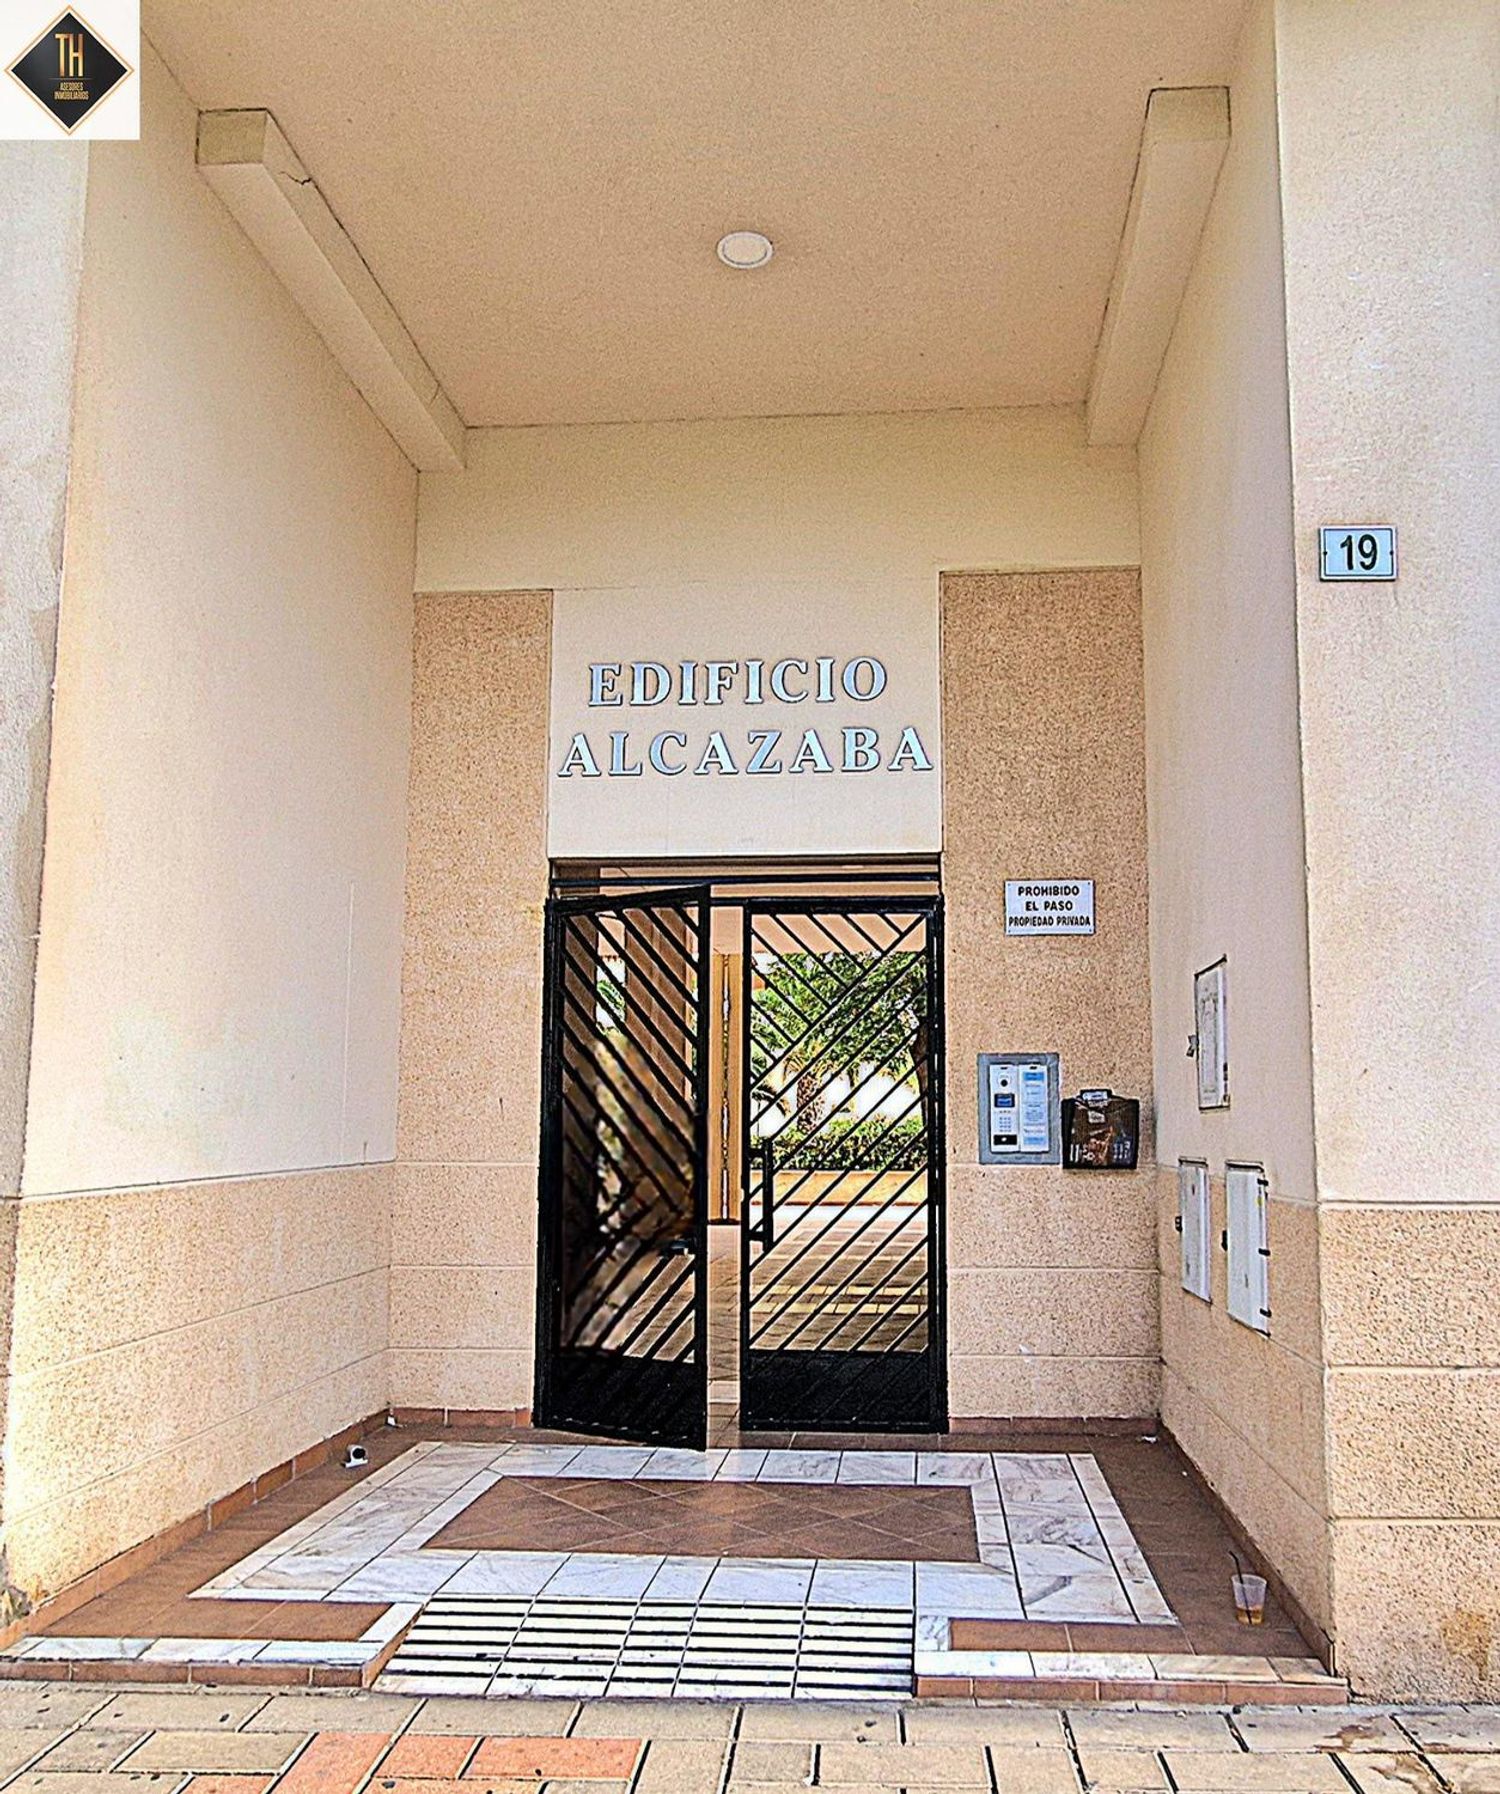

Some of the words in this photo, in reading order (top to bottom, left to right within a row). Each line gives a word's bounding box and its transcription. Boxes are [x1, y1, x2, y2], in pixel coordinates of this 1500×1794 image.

[1340, 534, 1378, 571] 19
[588, 657, 888, 707] EDIFICIO
[557, 727, 934, 777] ALCAZABA
[1018, 885, 1080, 896] PROHIBIDO
[1025, 901, 1039, 911] EL
[1044, 901, 1073, 911] PASO
[1008, 916, 1054, 927] PROPIEDAD
[1056, 916, 1091, 926] PRIVADA
